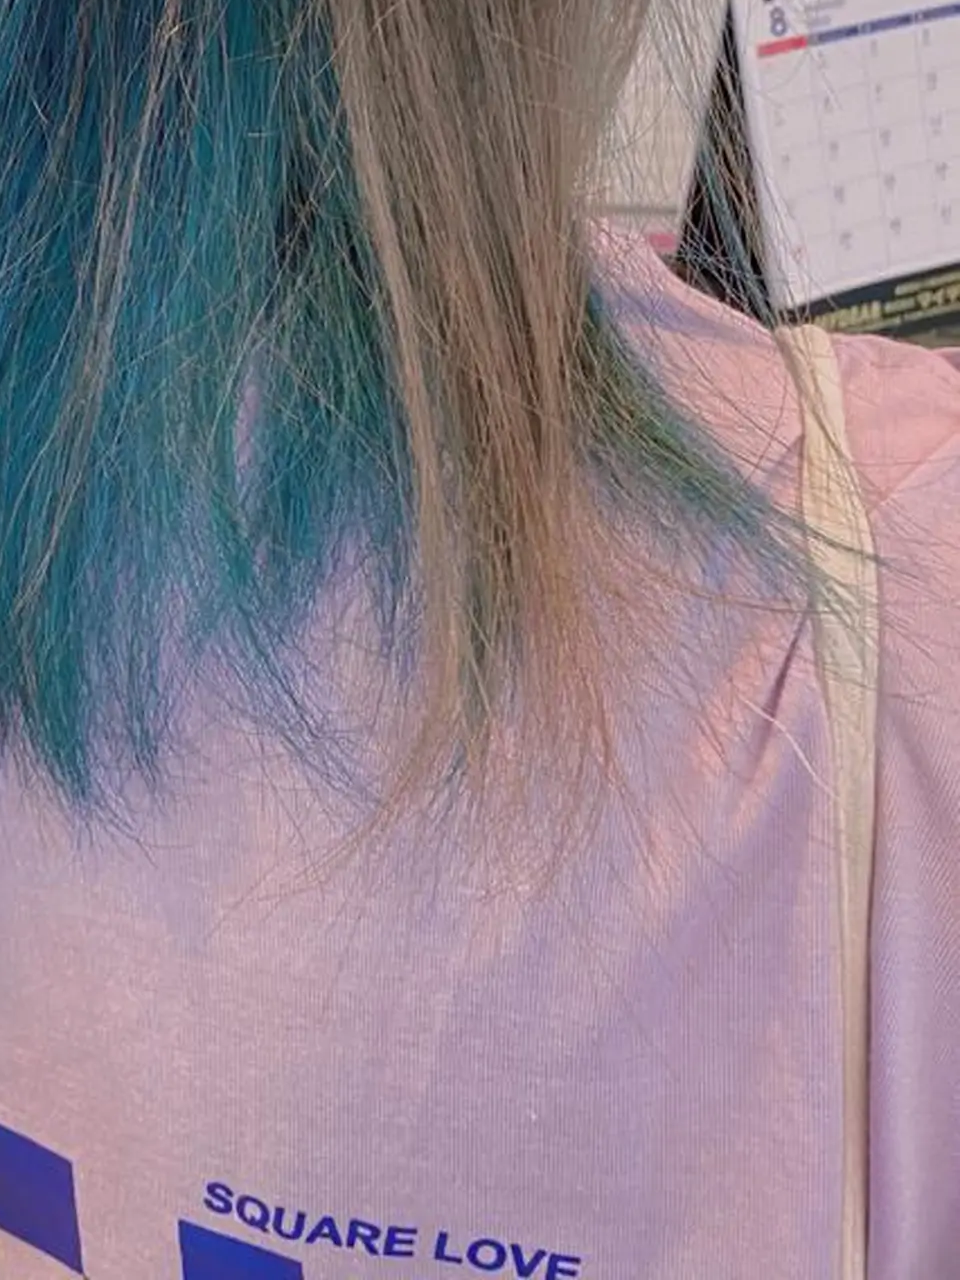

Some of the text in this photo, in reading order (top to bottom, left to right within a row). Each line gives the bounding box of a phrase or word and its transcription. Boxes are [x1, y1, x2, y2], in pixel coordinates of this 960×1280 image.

[770, 6, 788, 38] 8
[203, 1181, 582, 1280] SQUARE LOVE
